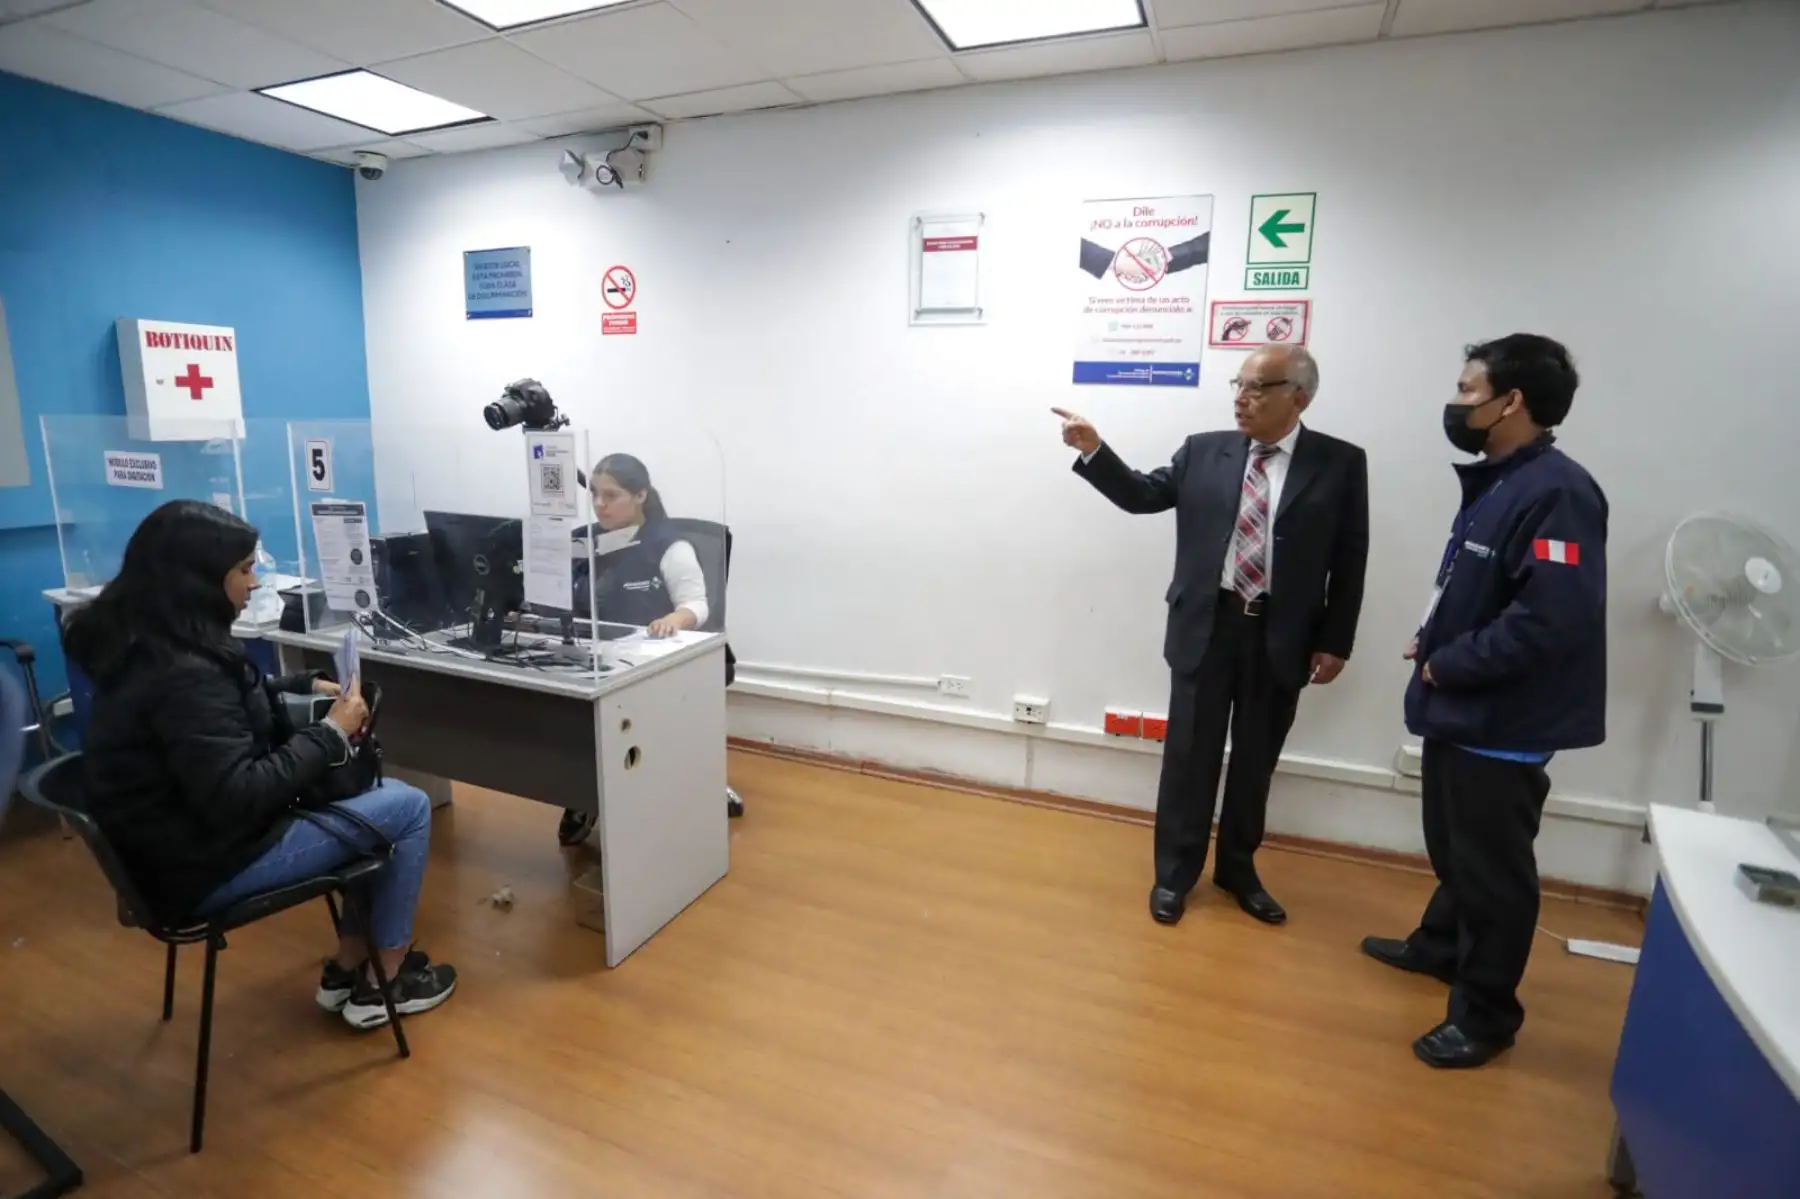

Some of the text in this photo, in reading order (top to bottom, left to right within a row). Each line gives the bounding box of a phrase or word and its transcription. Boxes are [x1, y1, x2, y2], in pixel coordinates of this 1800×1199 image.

[1133, 206, 1155, 217] Dile
[1114, 221, 1121, 229] a
[1123, 218, 1133, 228] la
[1135, 215, 1198, 228] corrupción!
[1253, 271, 1300, 286] SALIDA
[1171, 296, 1190, 304] acto
[145, 330, 232, 351] BOTIQUIN
[312, 448, 326, 481] 5
